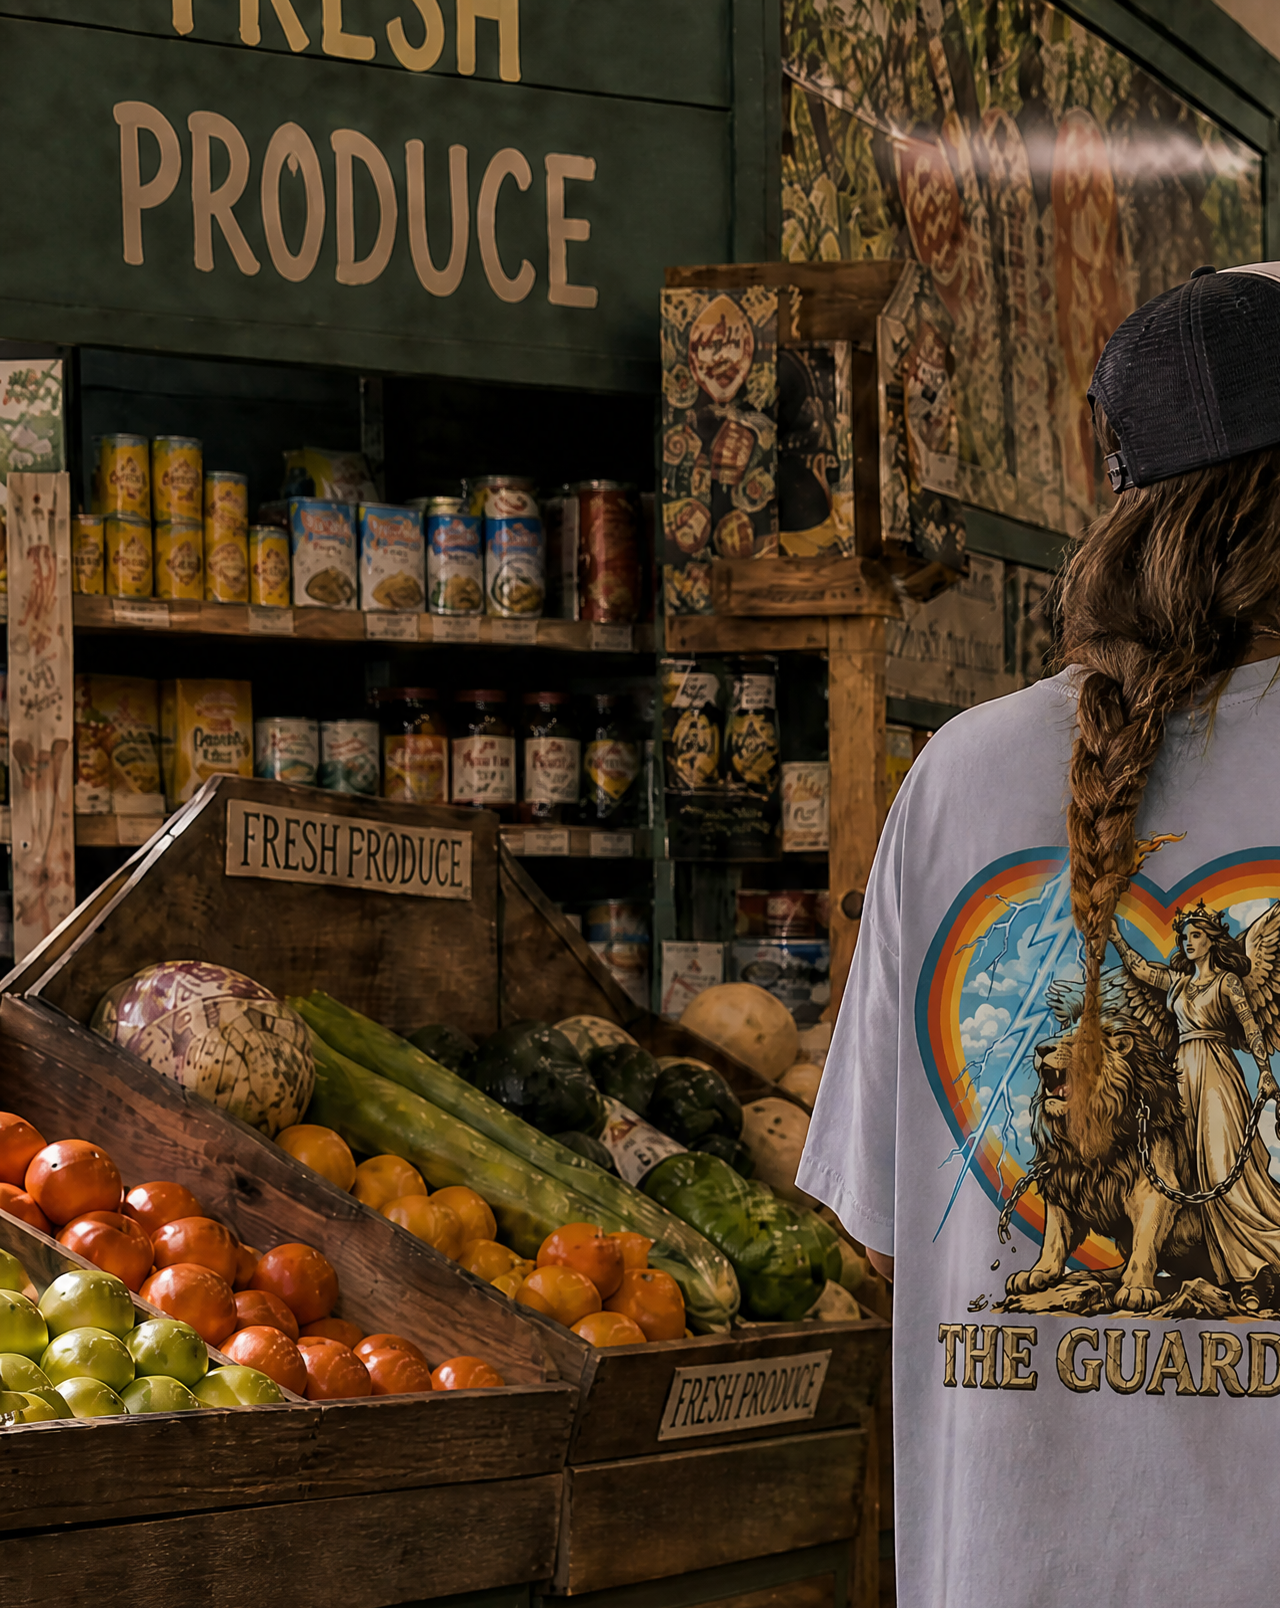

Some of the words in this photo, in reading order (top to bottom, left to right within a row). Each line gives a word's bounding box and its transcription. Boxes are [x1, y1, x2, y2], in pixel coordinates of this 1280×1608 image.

[113, 101, 598, 308] PRODUCE
[241, 811, 340, 876] FRESH
[347, 825, 463, 887] PRODUCE
[938, 1323, 1038, 1391] THE
[669, 1371, 742, 1428] FRESH
[733, 1362, 821, 1419] PRODUCE
